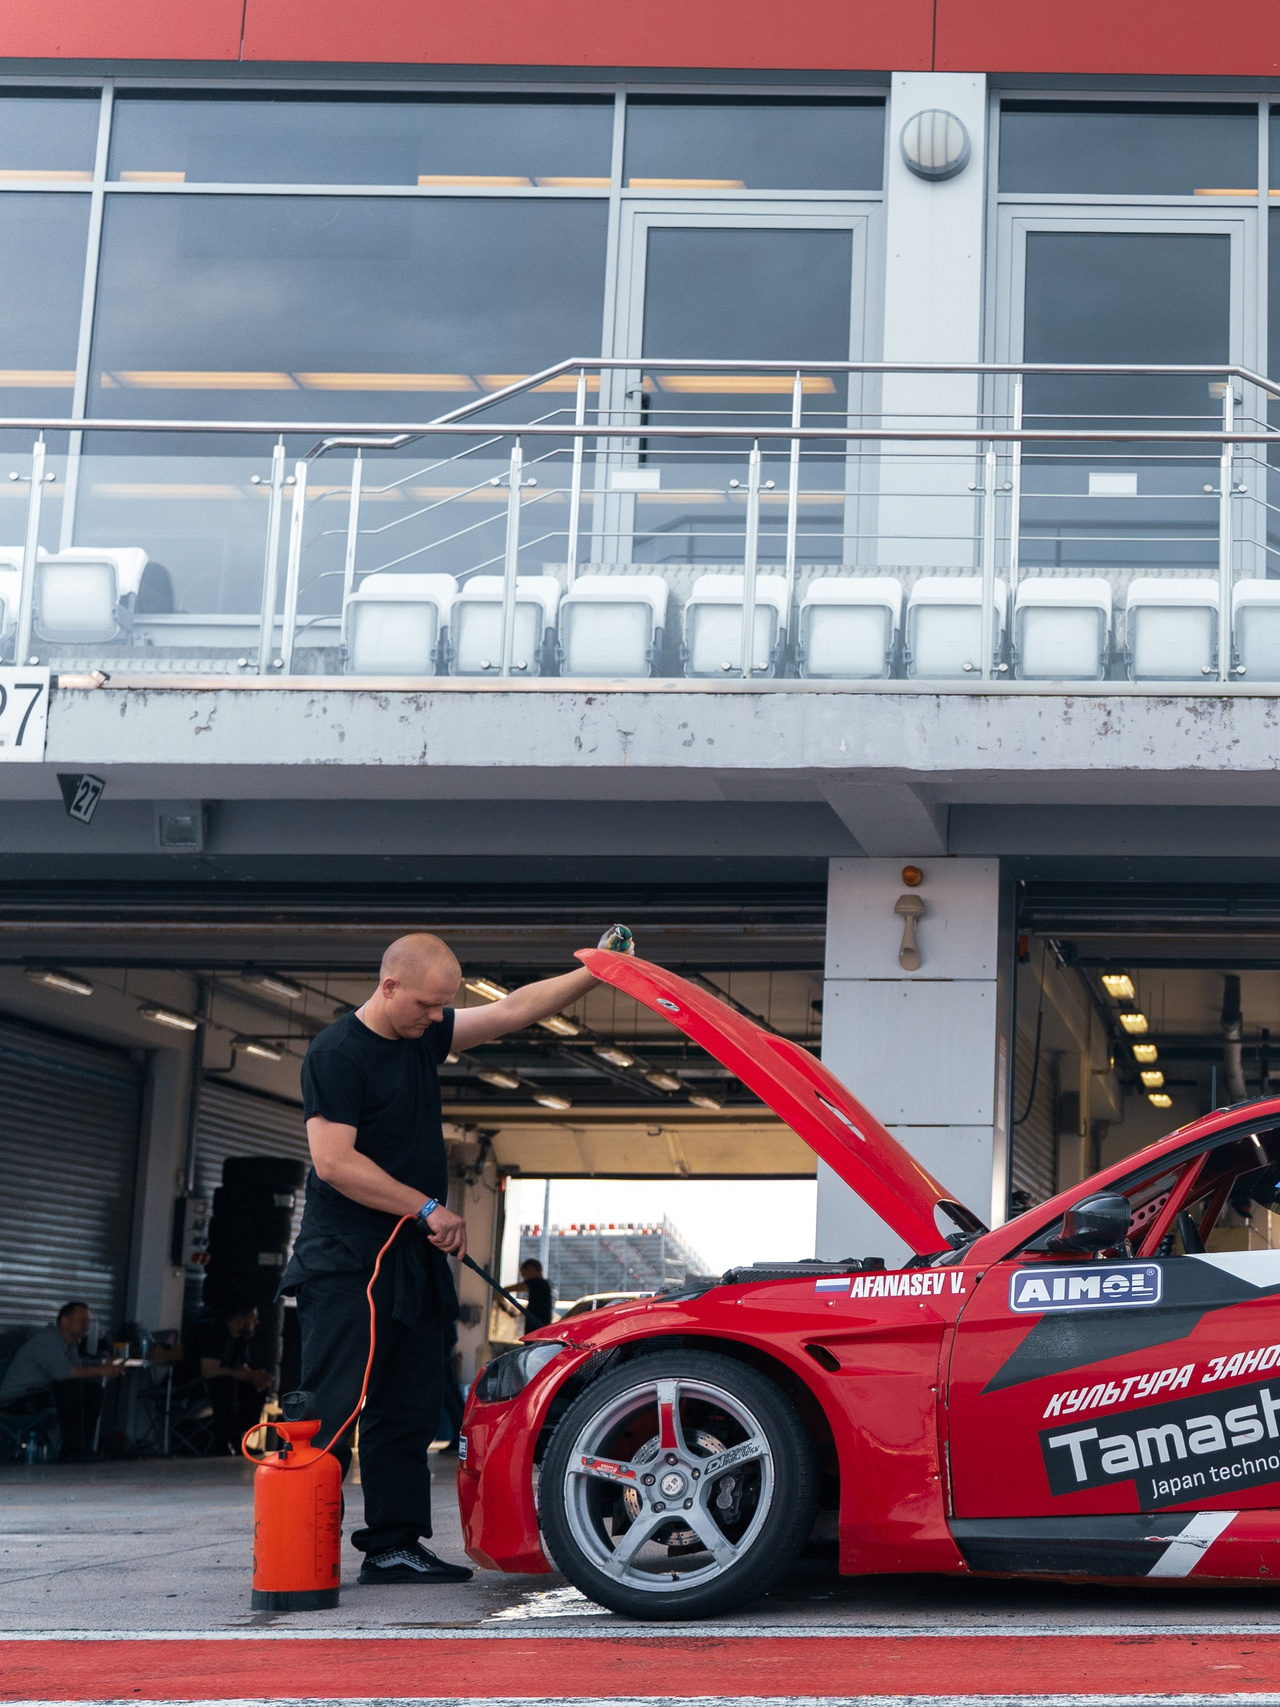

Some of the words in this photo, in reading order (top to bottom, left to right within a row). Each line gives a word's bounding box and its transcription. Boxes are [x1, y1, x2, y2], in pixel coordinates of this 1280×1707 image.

[0, 684, 44, 746] 7
[73, 781, 100, 816] 27
[850, 1273, 945, 1298] AFANASEV
[951, 1272, 966, 1294] V.
[1017, 1273, 1154, 1303] AIMOL
[1043, 1363, 1195, 1418] КУЛЬТУРА
[1151, 1468, 1205, 1499] Japan
